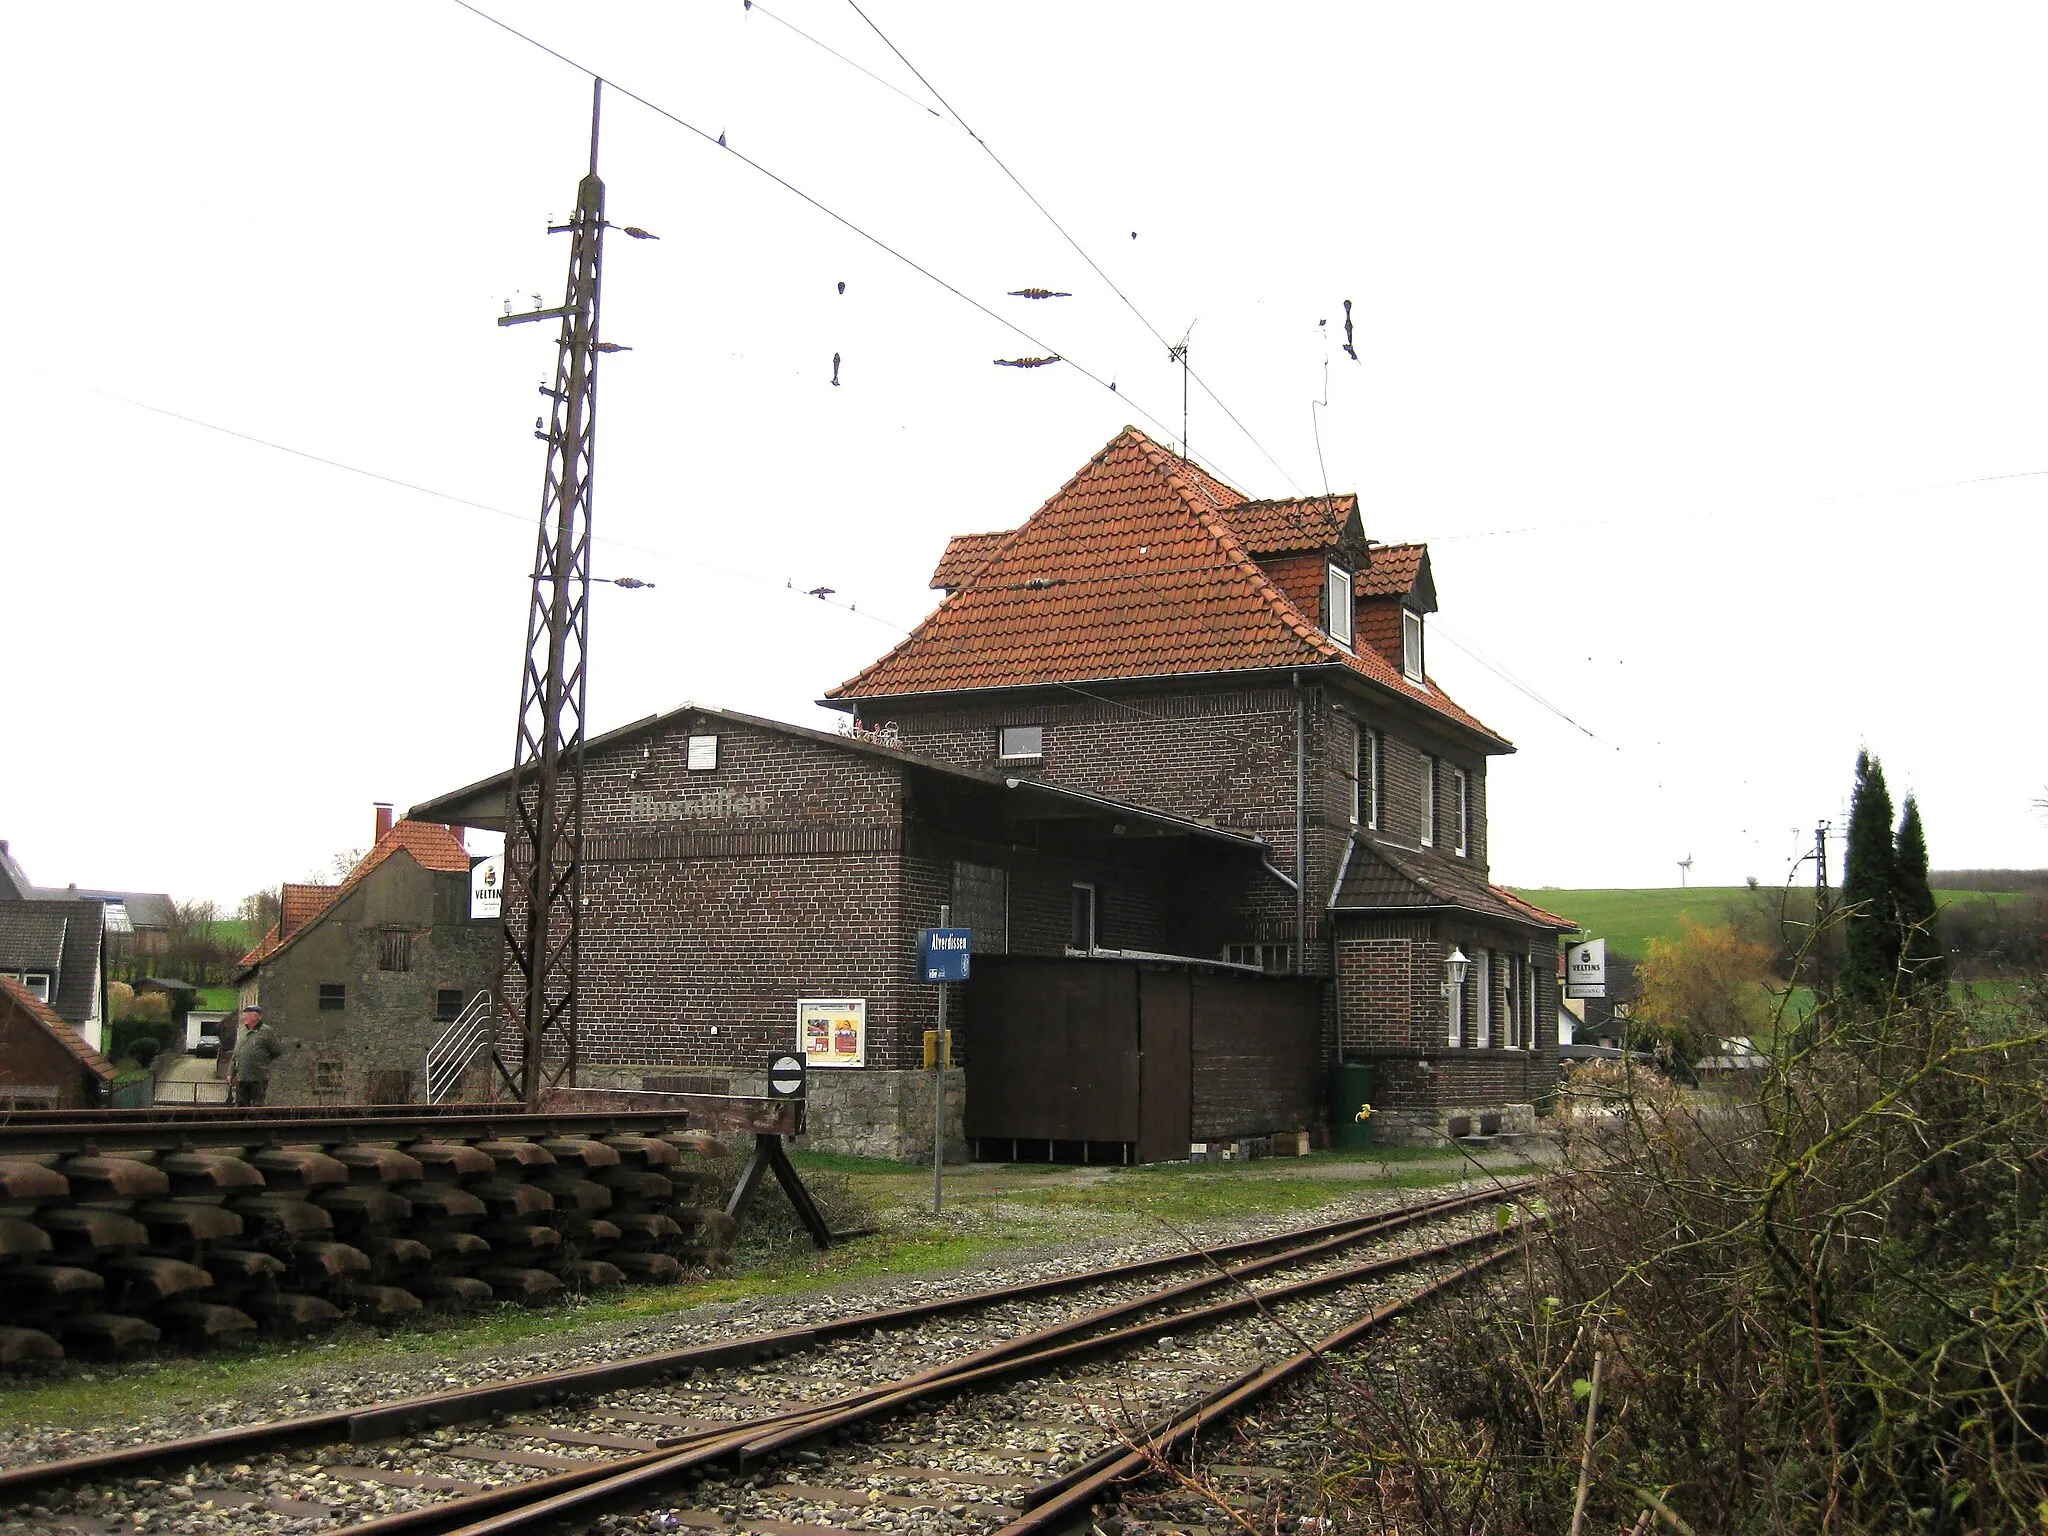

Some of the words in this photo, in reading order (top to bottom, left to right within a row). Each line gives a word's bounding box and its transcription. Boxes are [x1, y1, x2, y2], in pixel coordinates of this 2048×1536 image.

[475, 889, 502, 899] VELTIN
[931, 933, 967, 950] Alverdissen
[1572, 964, 1600, 972] VELTINS
